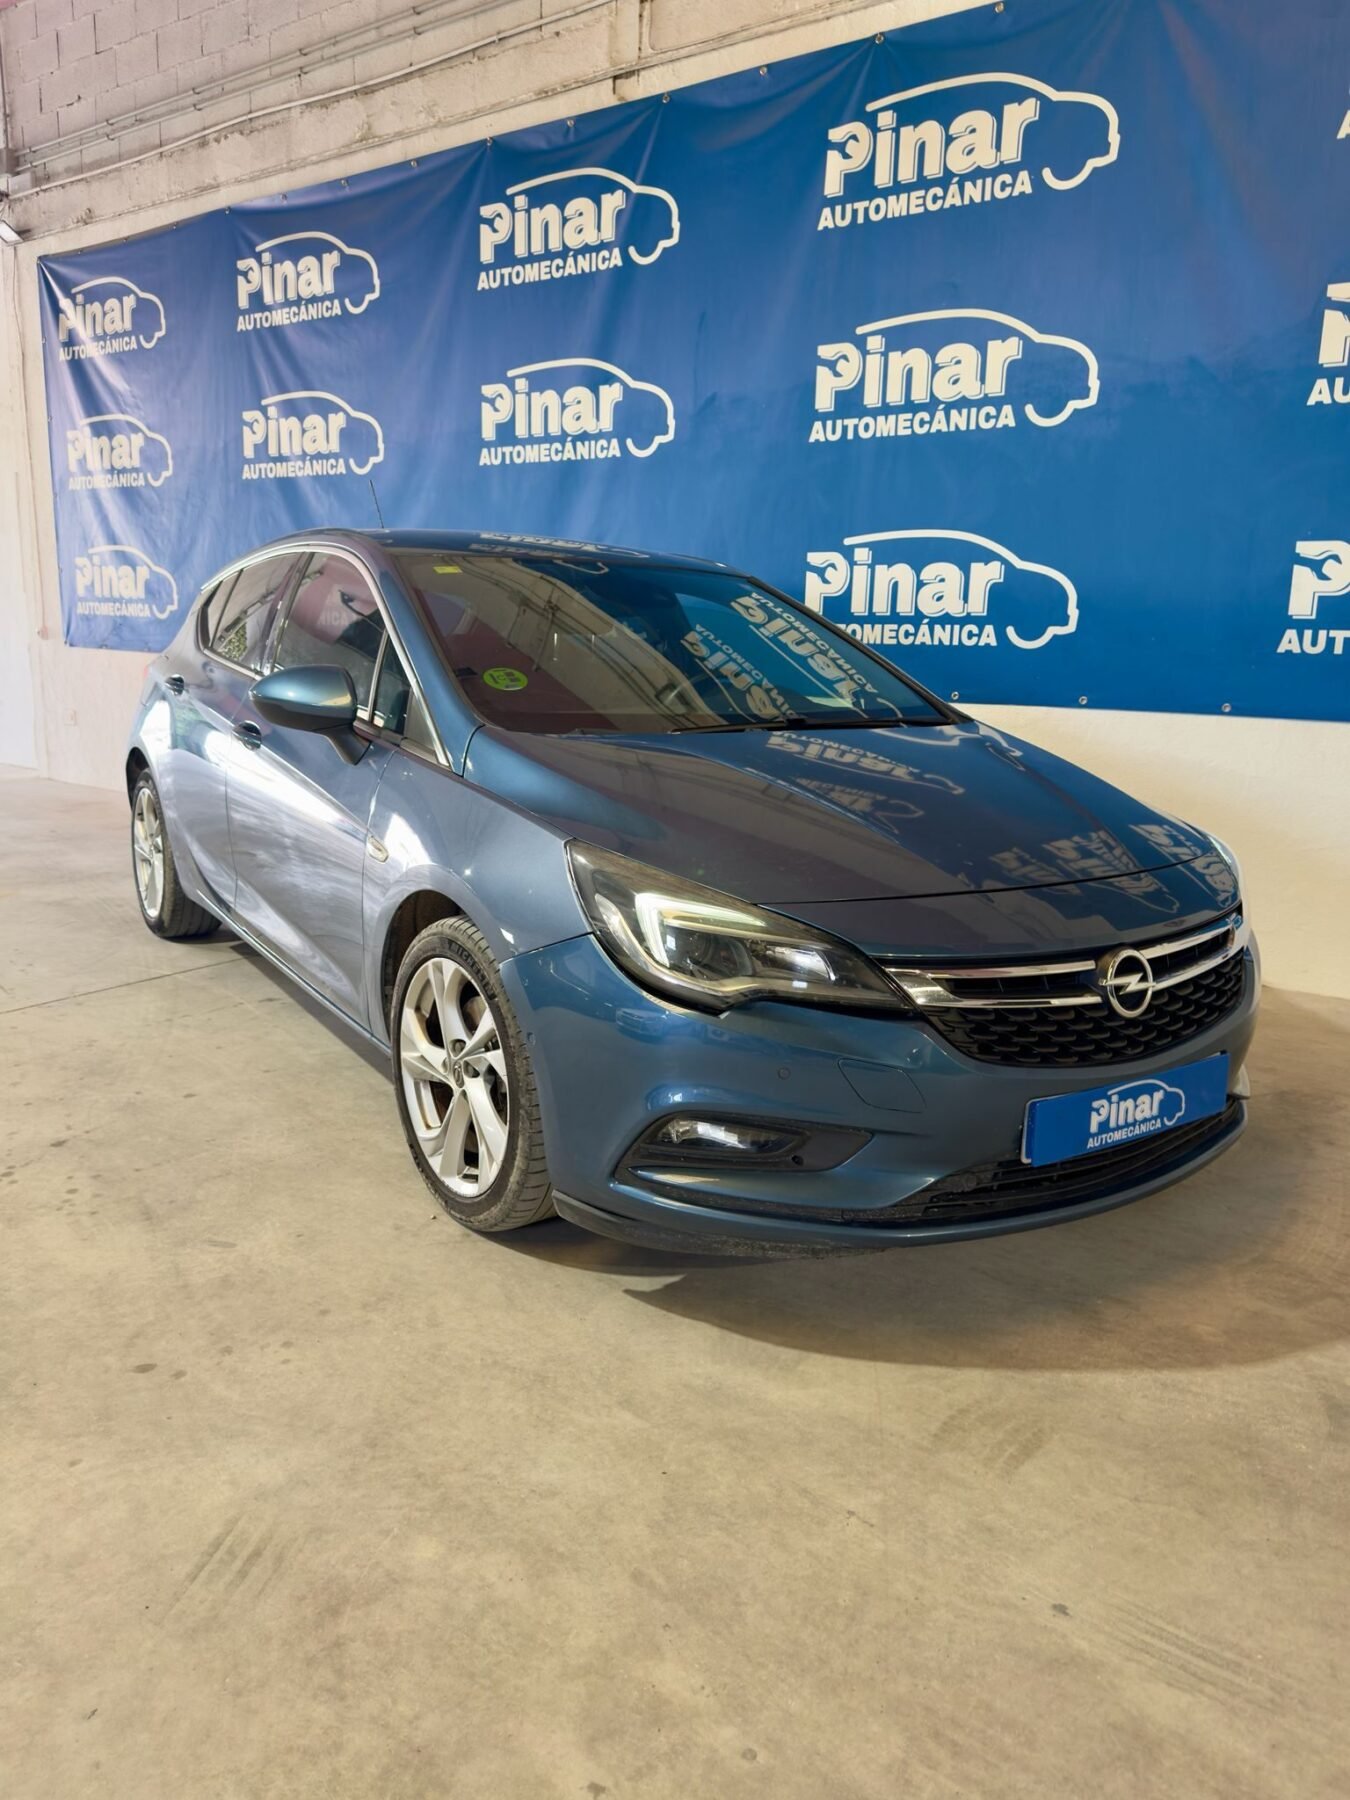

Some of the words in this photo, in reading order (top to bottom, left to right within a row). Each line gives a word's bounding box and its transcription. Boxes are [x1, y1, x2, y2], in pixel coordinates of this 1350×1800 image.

[824, 98, 1040, 198] Pinar
[817, 170, 1033, 231] AUTOMECÁNICA
[480, 189, 625, 264] Pinar
[237, 251, 341, 309] Pinar
[477, 247, 623, 291] AUTOMECÁNICA
[59, 294, 137, 342] Pinar
[237, 299, 342, 332] AUTOMECÁNICA
[815, 335, 1023, 412] Pinar
[242, 406, 346, 459] Pinar
[481, 378, 623, 441] Pinar
[808, 404, 1016, 443] AUTOMECÁNICA
[67, 425, 144, 473] Pinar
[242, 456, 346, 480] AUTOMECÁNICA
[479, 437, 621, 466] AUTOMECÁNICA
[74, 555, 150, 599] Pinar
[805, 547, 1005, 617] Pinar
[1087, 1118, 1162, 1149] AUTOMECÁNICA
[1089, 1089, 1165, 1134] Pinar
